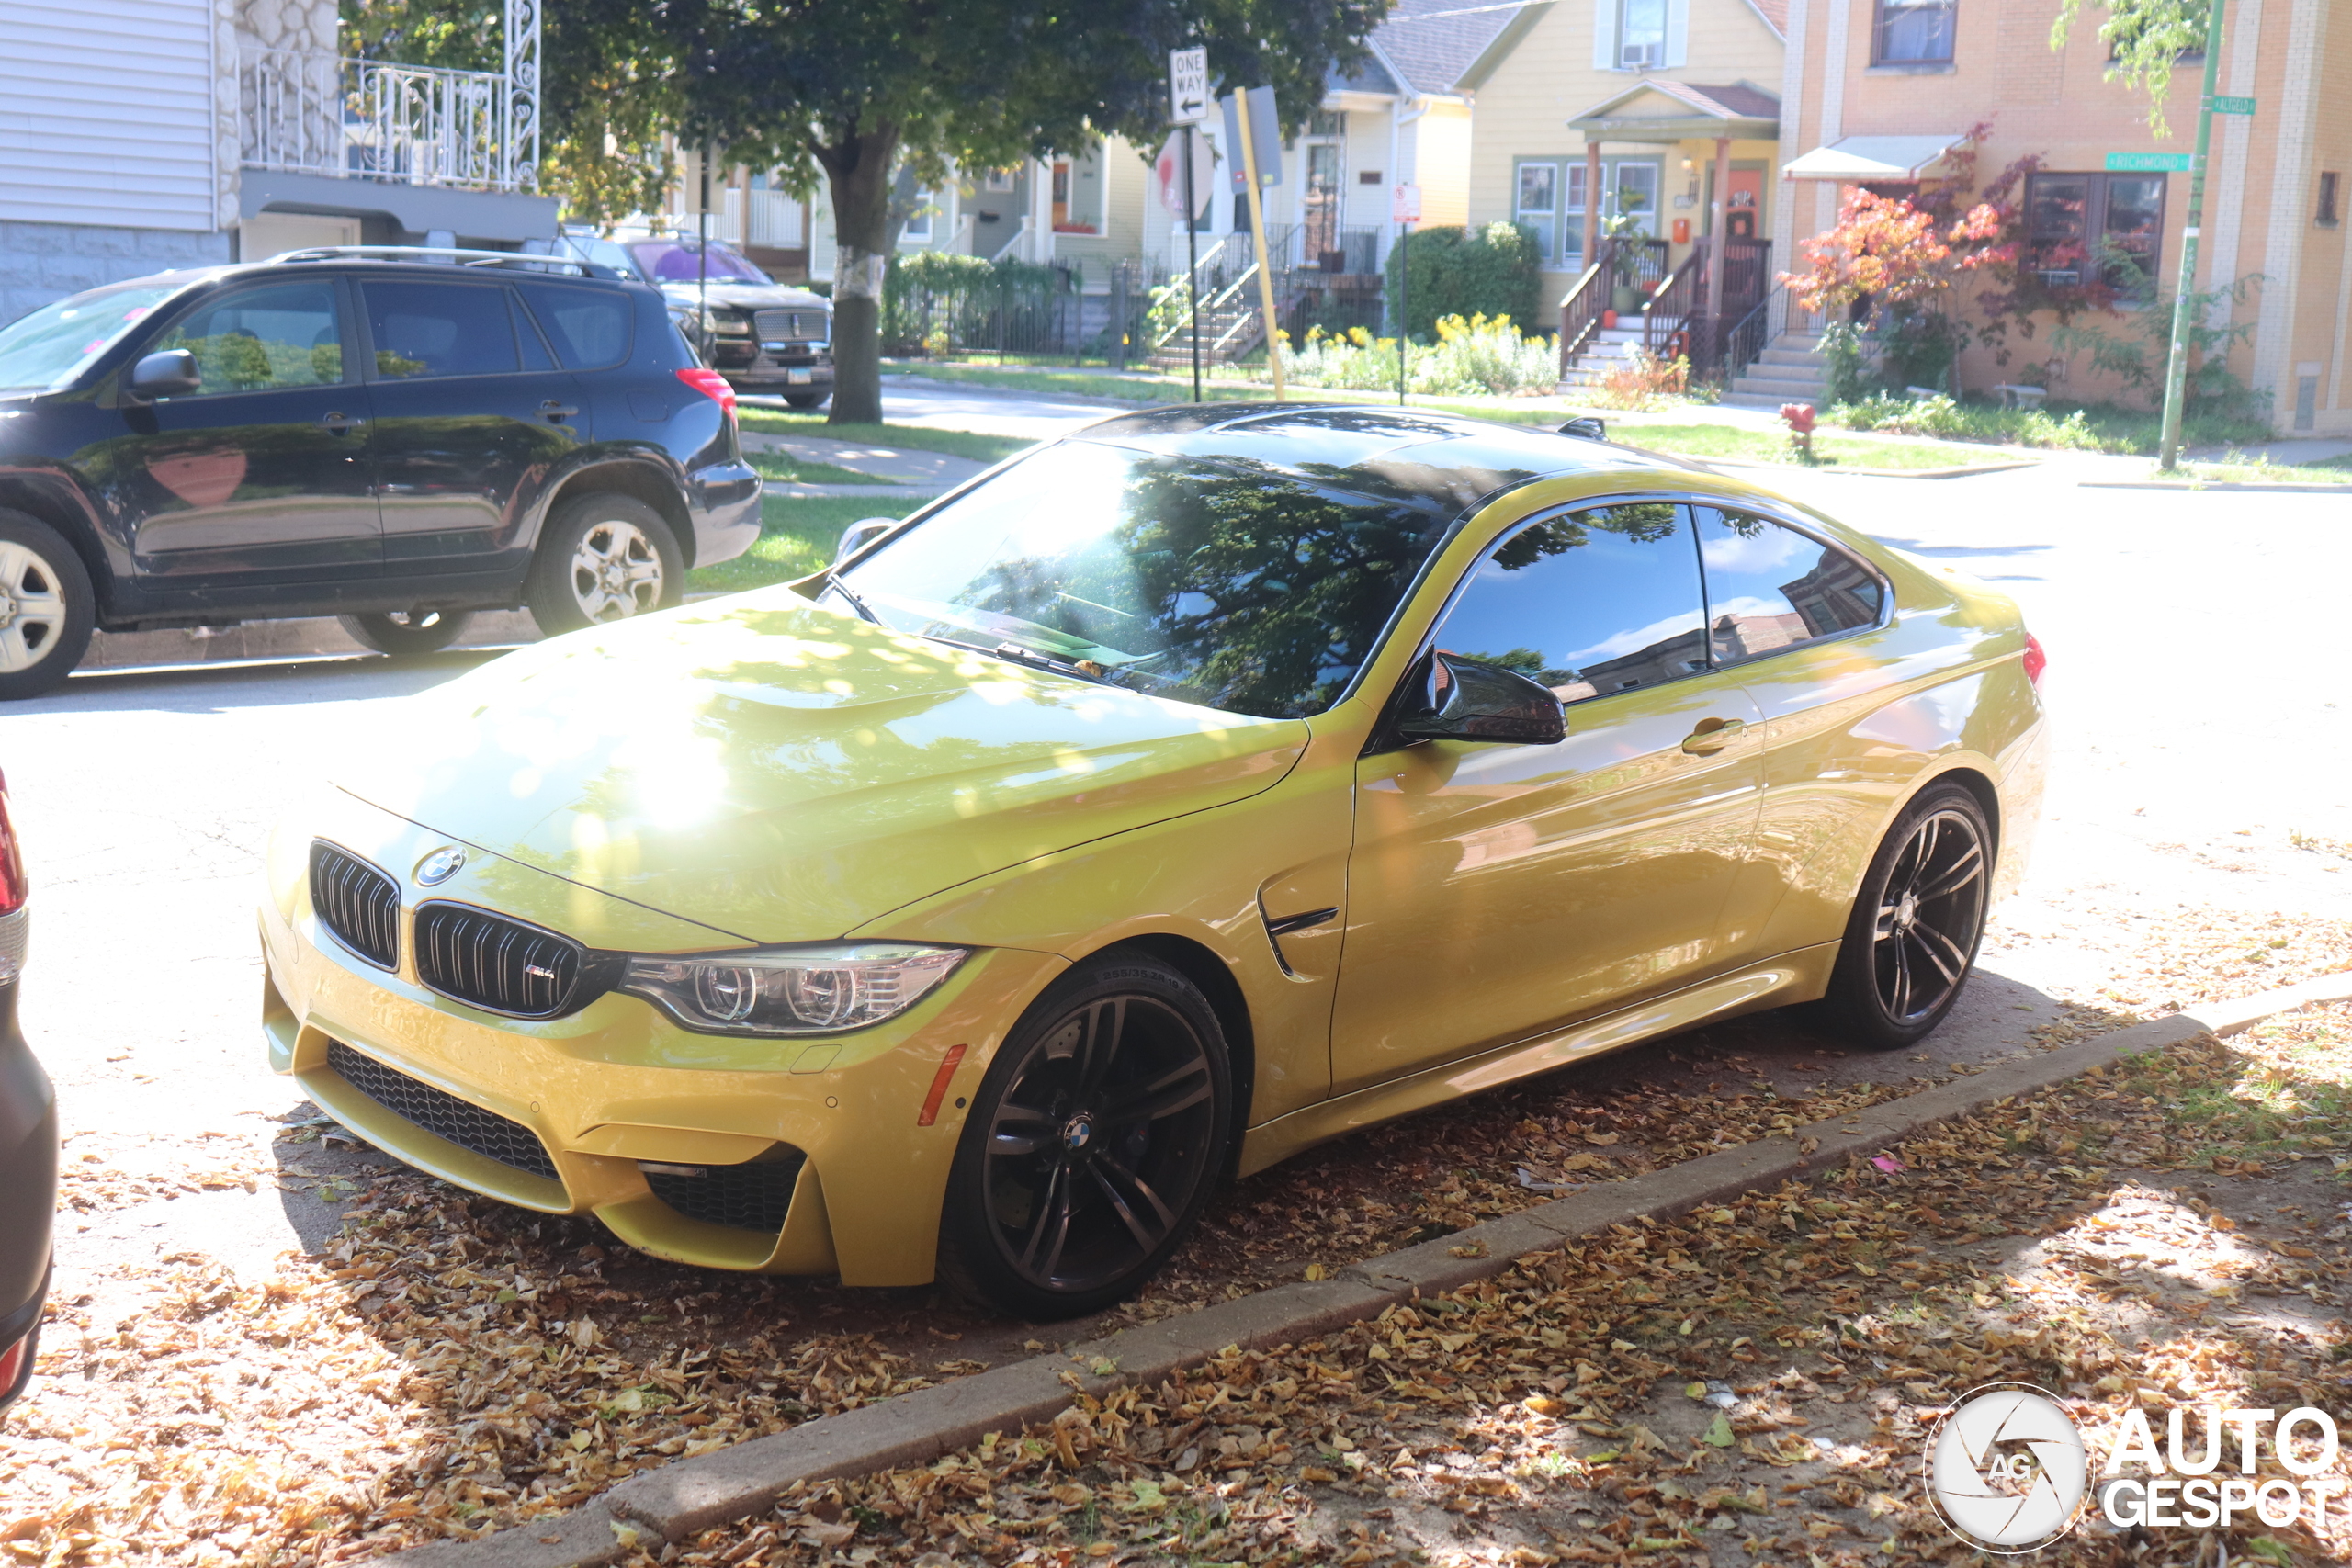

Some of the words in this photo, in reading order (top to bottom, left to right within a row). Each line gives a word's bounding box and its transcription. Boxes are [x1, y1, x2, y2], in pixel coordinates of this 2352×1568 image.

[1177, 54, 1203, 73] ONE
[1177, 74, 1203, 93] WAY
[2220, 97, 2249, 112] ALTGELD
[2115, 154, 2178, 169] RICHMOND
[530, 965, 555, 979] M4
[1103, 968, 1148, 980] 255/35
[1150, 971, 1165, 982] ZR
[1168, 978, 1179, 989] 19
